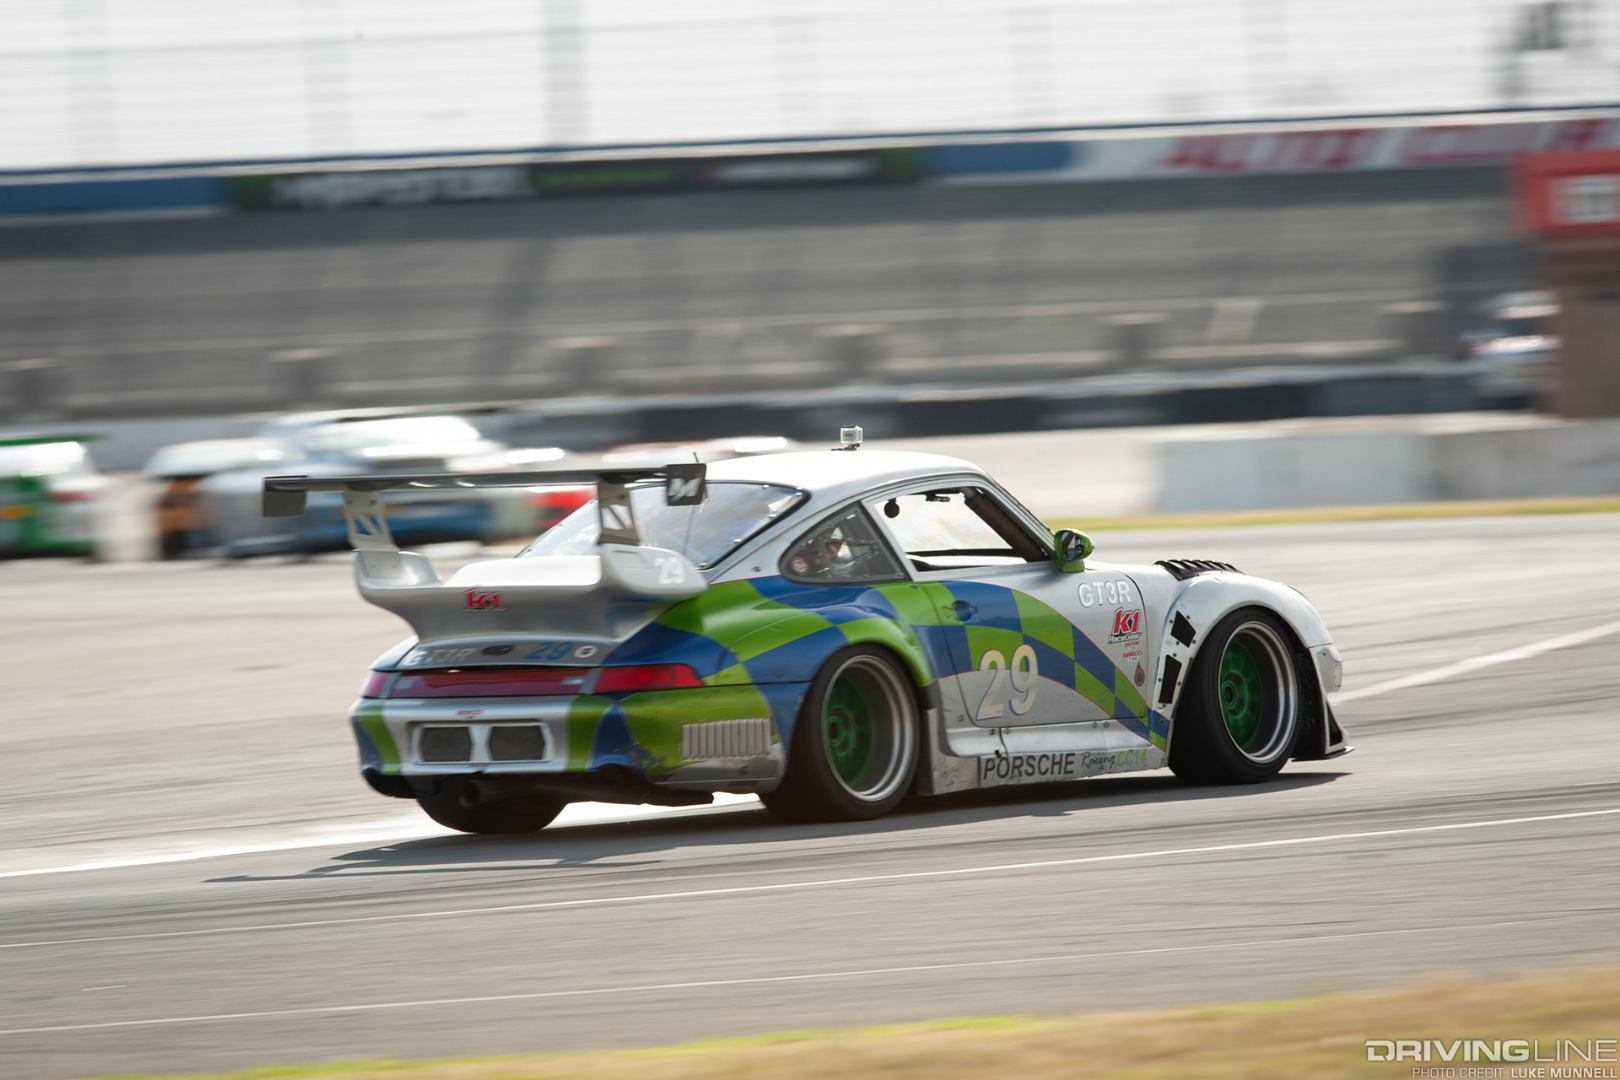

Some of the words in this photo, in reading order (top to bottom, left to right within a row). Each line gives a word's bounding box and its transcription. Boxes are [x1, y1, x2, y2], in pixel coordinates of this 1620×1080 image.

[655, 556, 685, 584] 29
[1078, 580, 1132, 608] GT3R
[524, 641, 575, 661] 29
[976, 644, 1039, 721] 29
[983, 752, 1076, 781] PORSCHE
